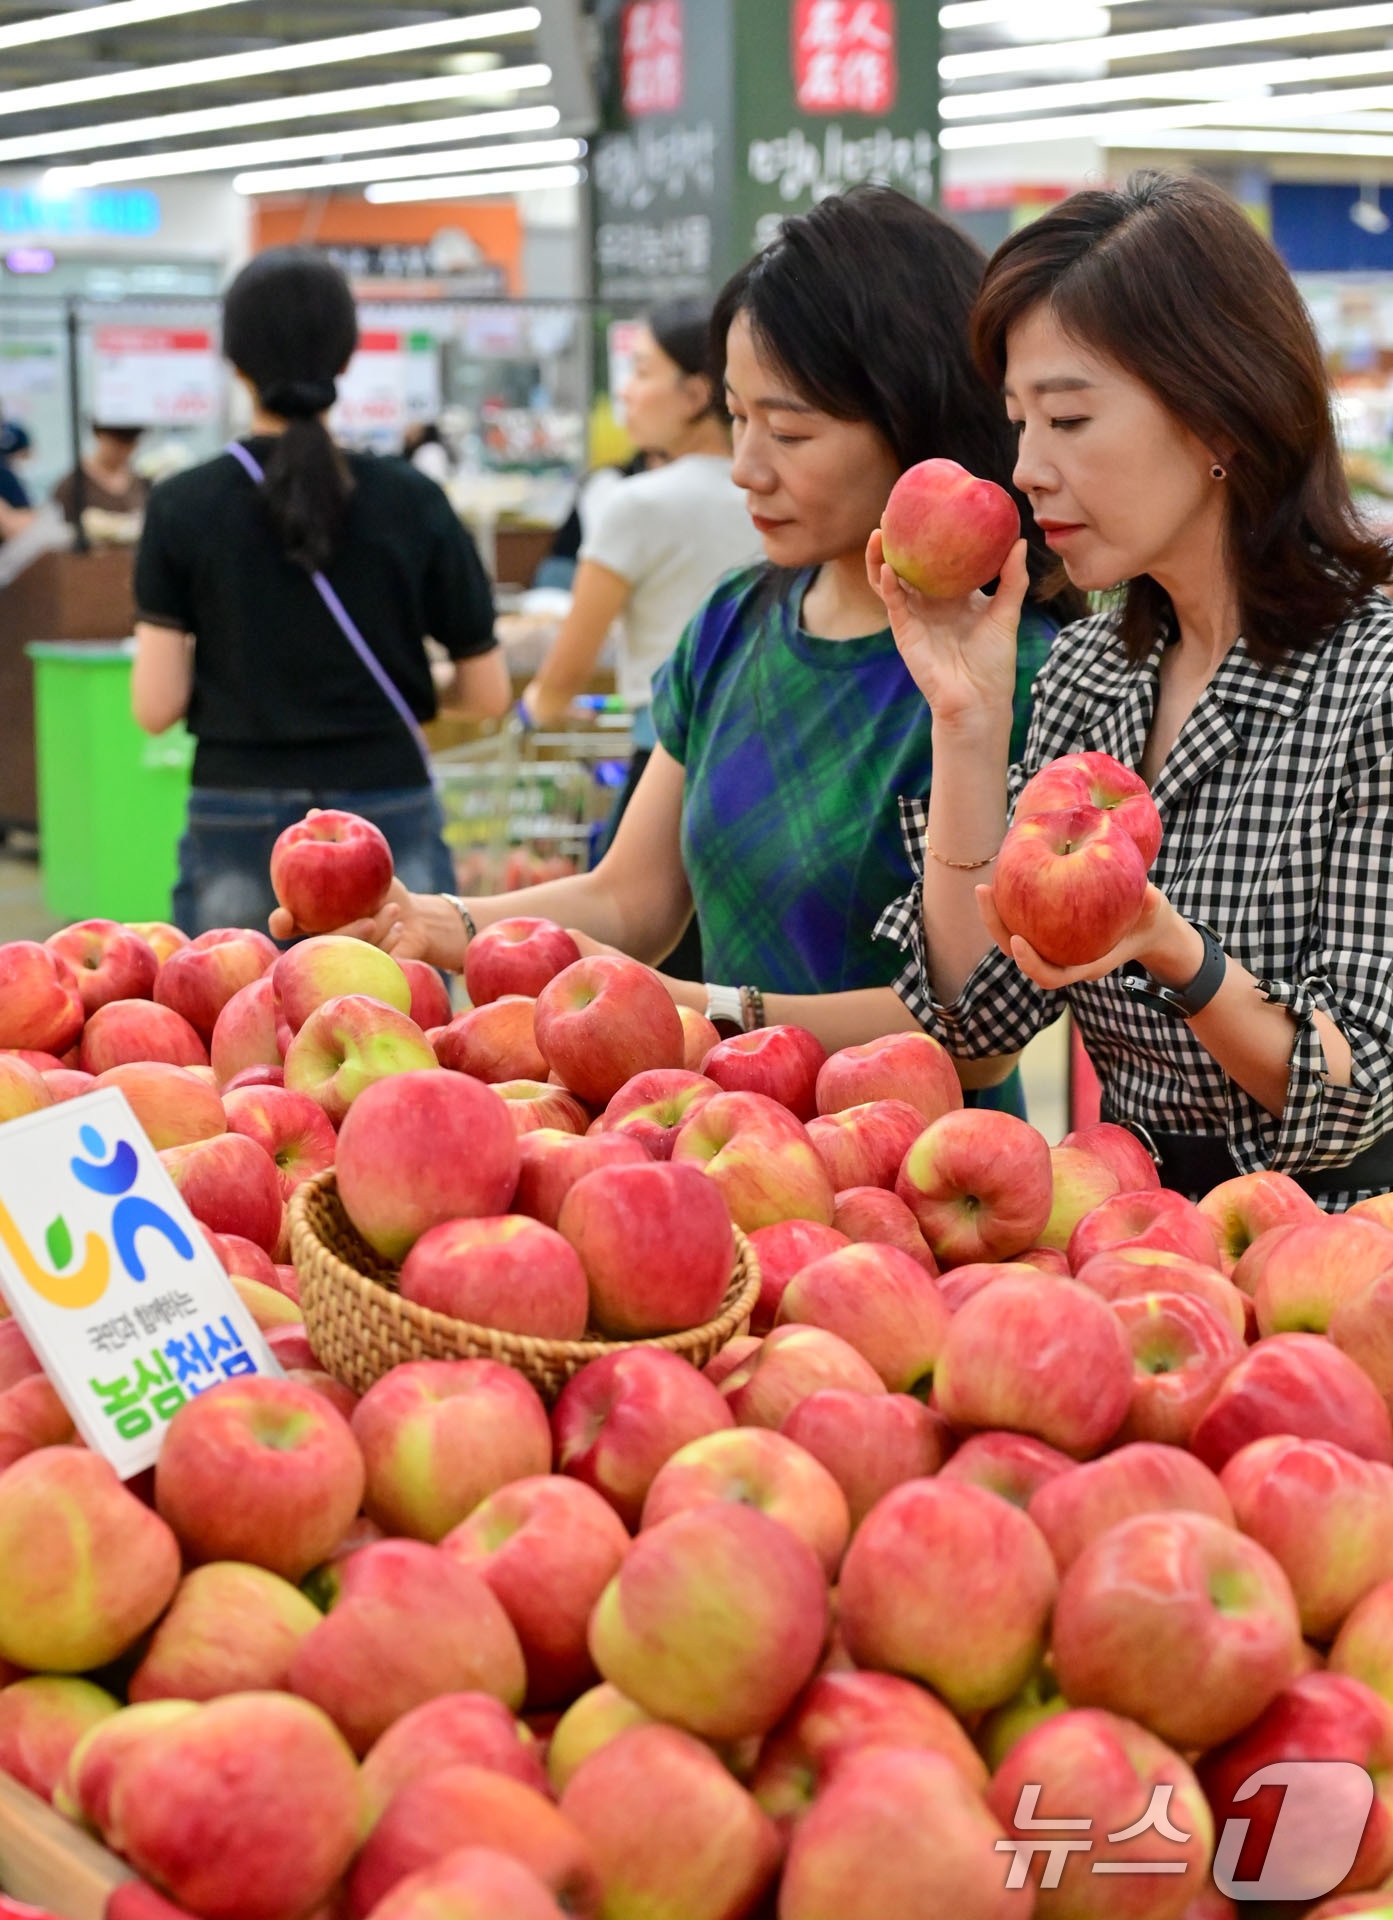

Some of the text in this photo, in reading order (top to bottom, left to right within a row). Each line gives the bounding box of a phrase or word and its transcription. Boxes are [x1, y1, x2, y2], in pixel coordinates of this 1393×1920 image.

[86, 1289, 199, 1353] 국민과 함께하는
[89, 1315, 258, 1440] 농심천심
